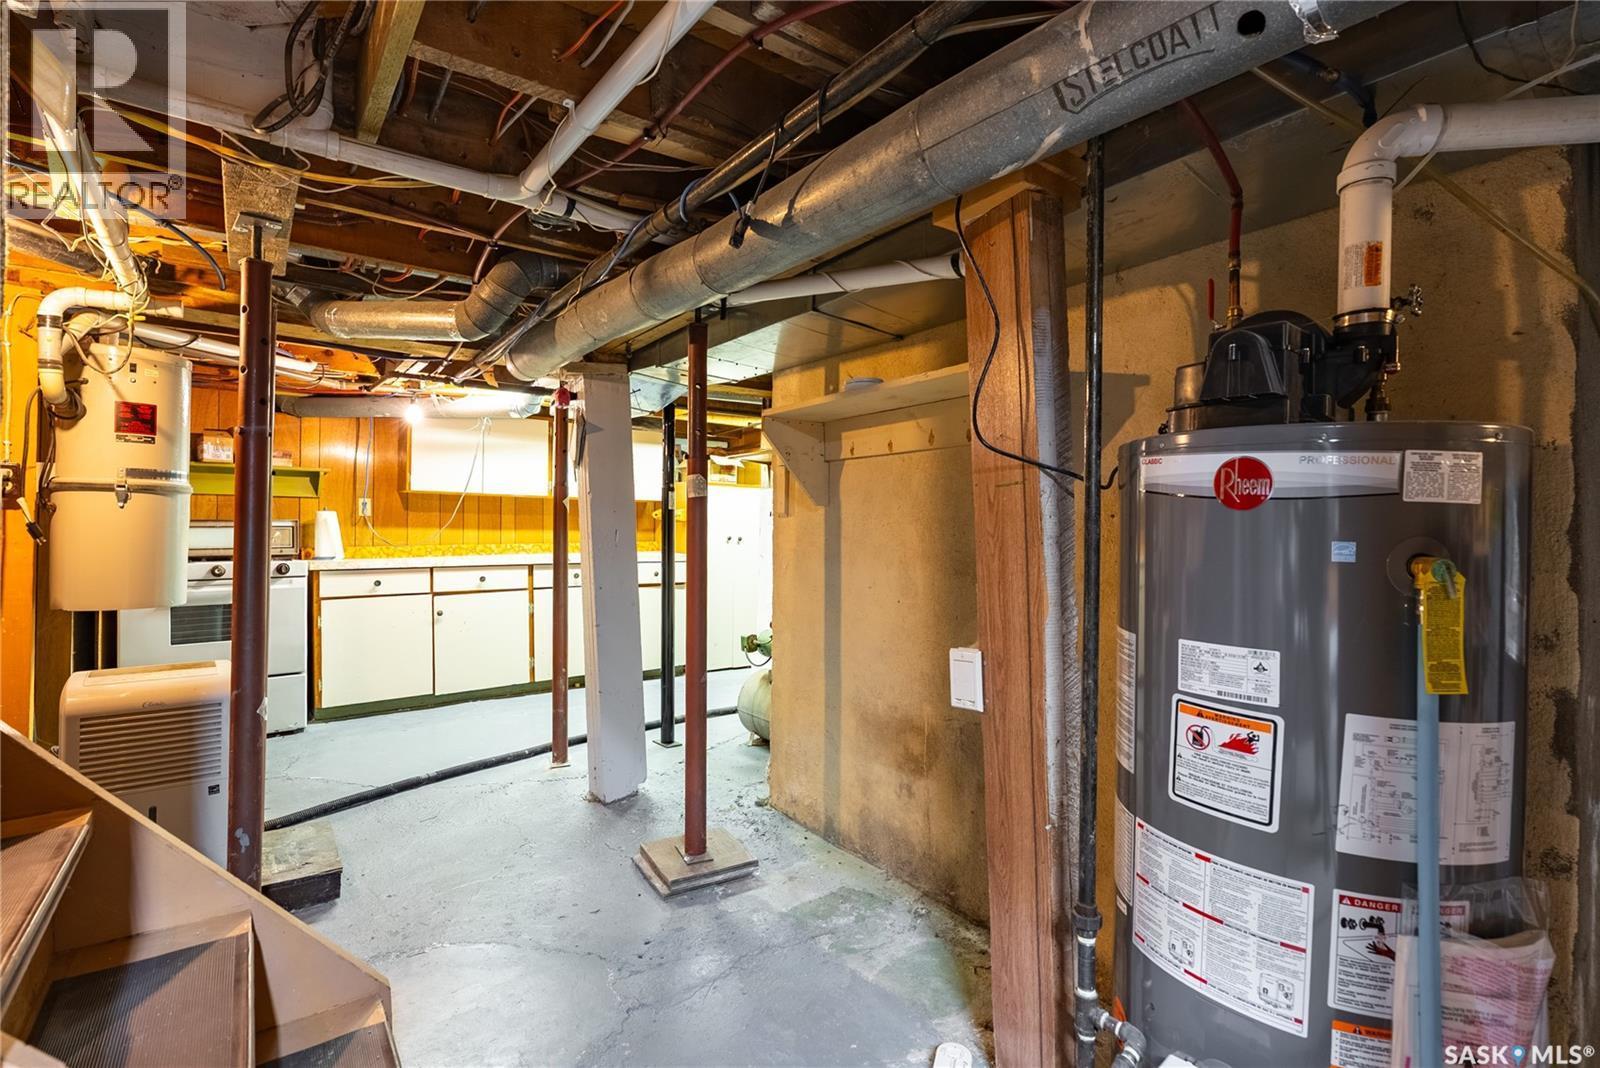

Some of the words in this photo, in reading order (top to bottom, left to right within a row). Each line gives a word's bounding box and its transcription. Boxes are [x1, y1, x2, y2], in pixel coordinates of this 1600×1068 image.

[1299, 455, 1396, 465] PROFESSIONAL
[1220, 459, 1271, 503] Rheem
[1354, 900, 1399, 912] DANGER
